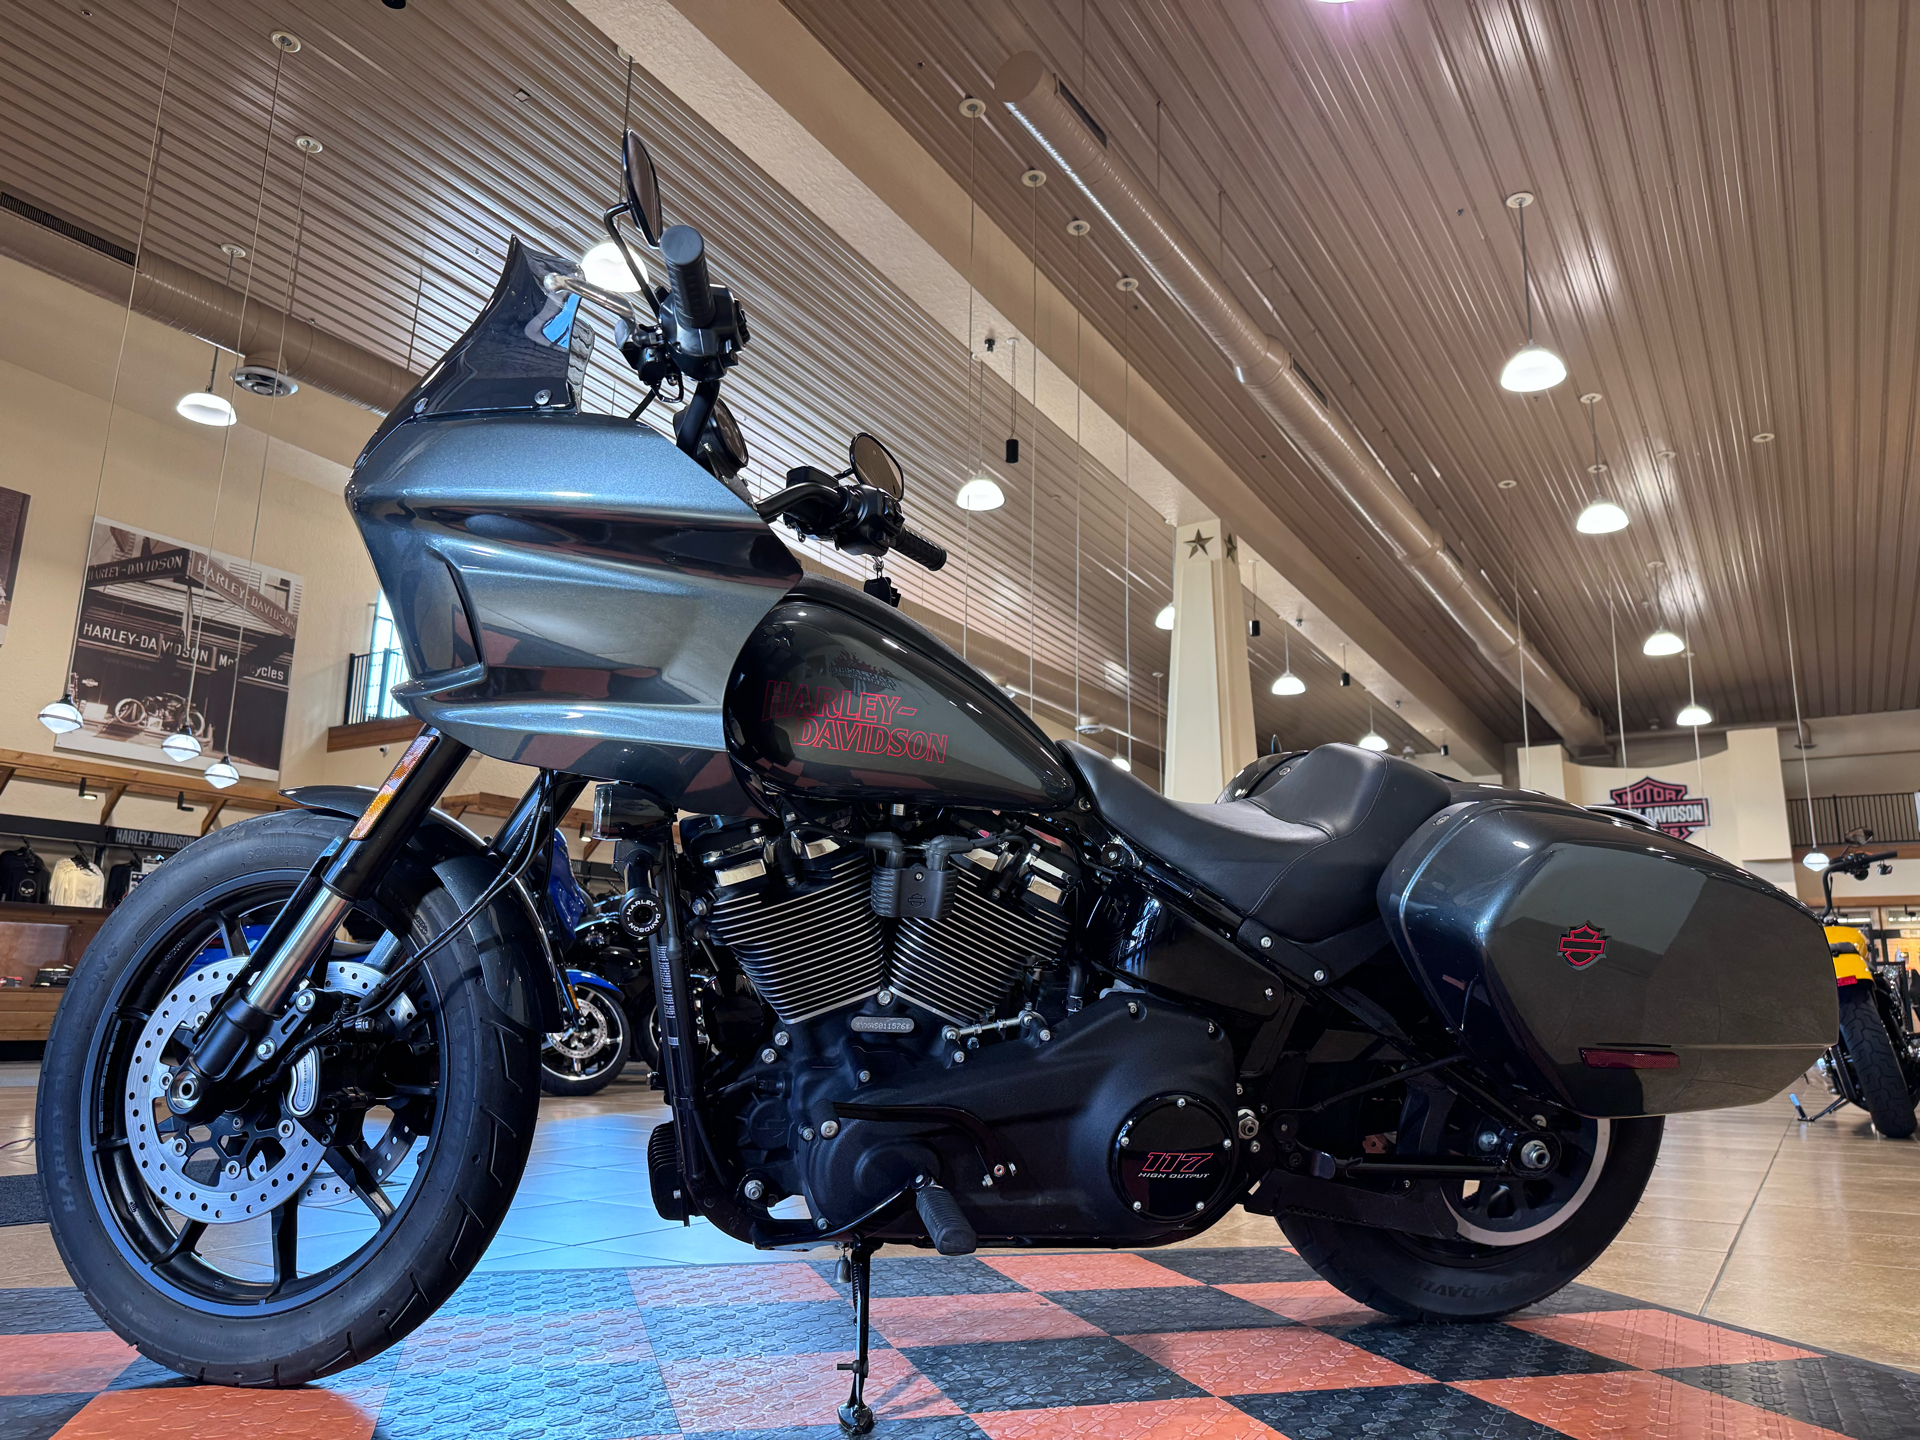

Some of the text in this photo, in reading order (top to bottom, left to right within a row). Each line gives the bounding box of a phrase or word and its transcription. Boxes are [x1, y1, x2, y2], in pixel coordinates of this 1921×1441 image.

[88, 555, 184, 581] HARLEY-DAVIDSON
[197, 560, 297, 630] HARLEY-DAVIDSON
[83, 622, 209, 663] HARLEY-DAVIDSON
[793, 716, 948, 763] DAVIDSON
[1621, 784, 1677, 804] MOTOR
[115, 829, 195, 849] HARLEY-DAVIDSON
[1141, 1151, 1214, 1173] 117
